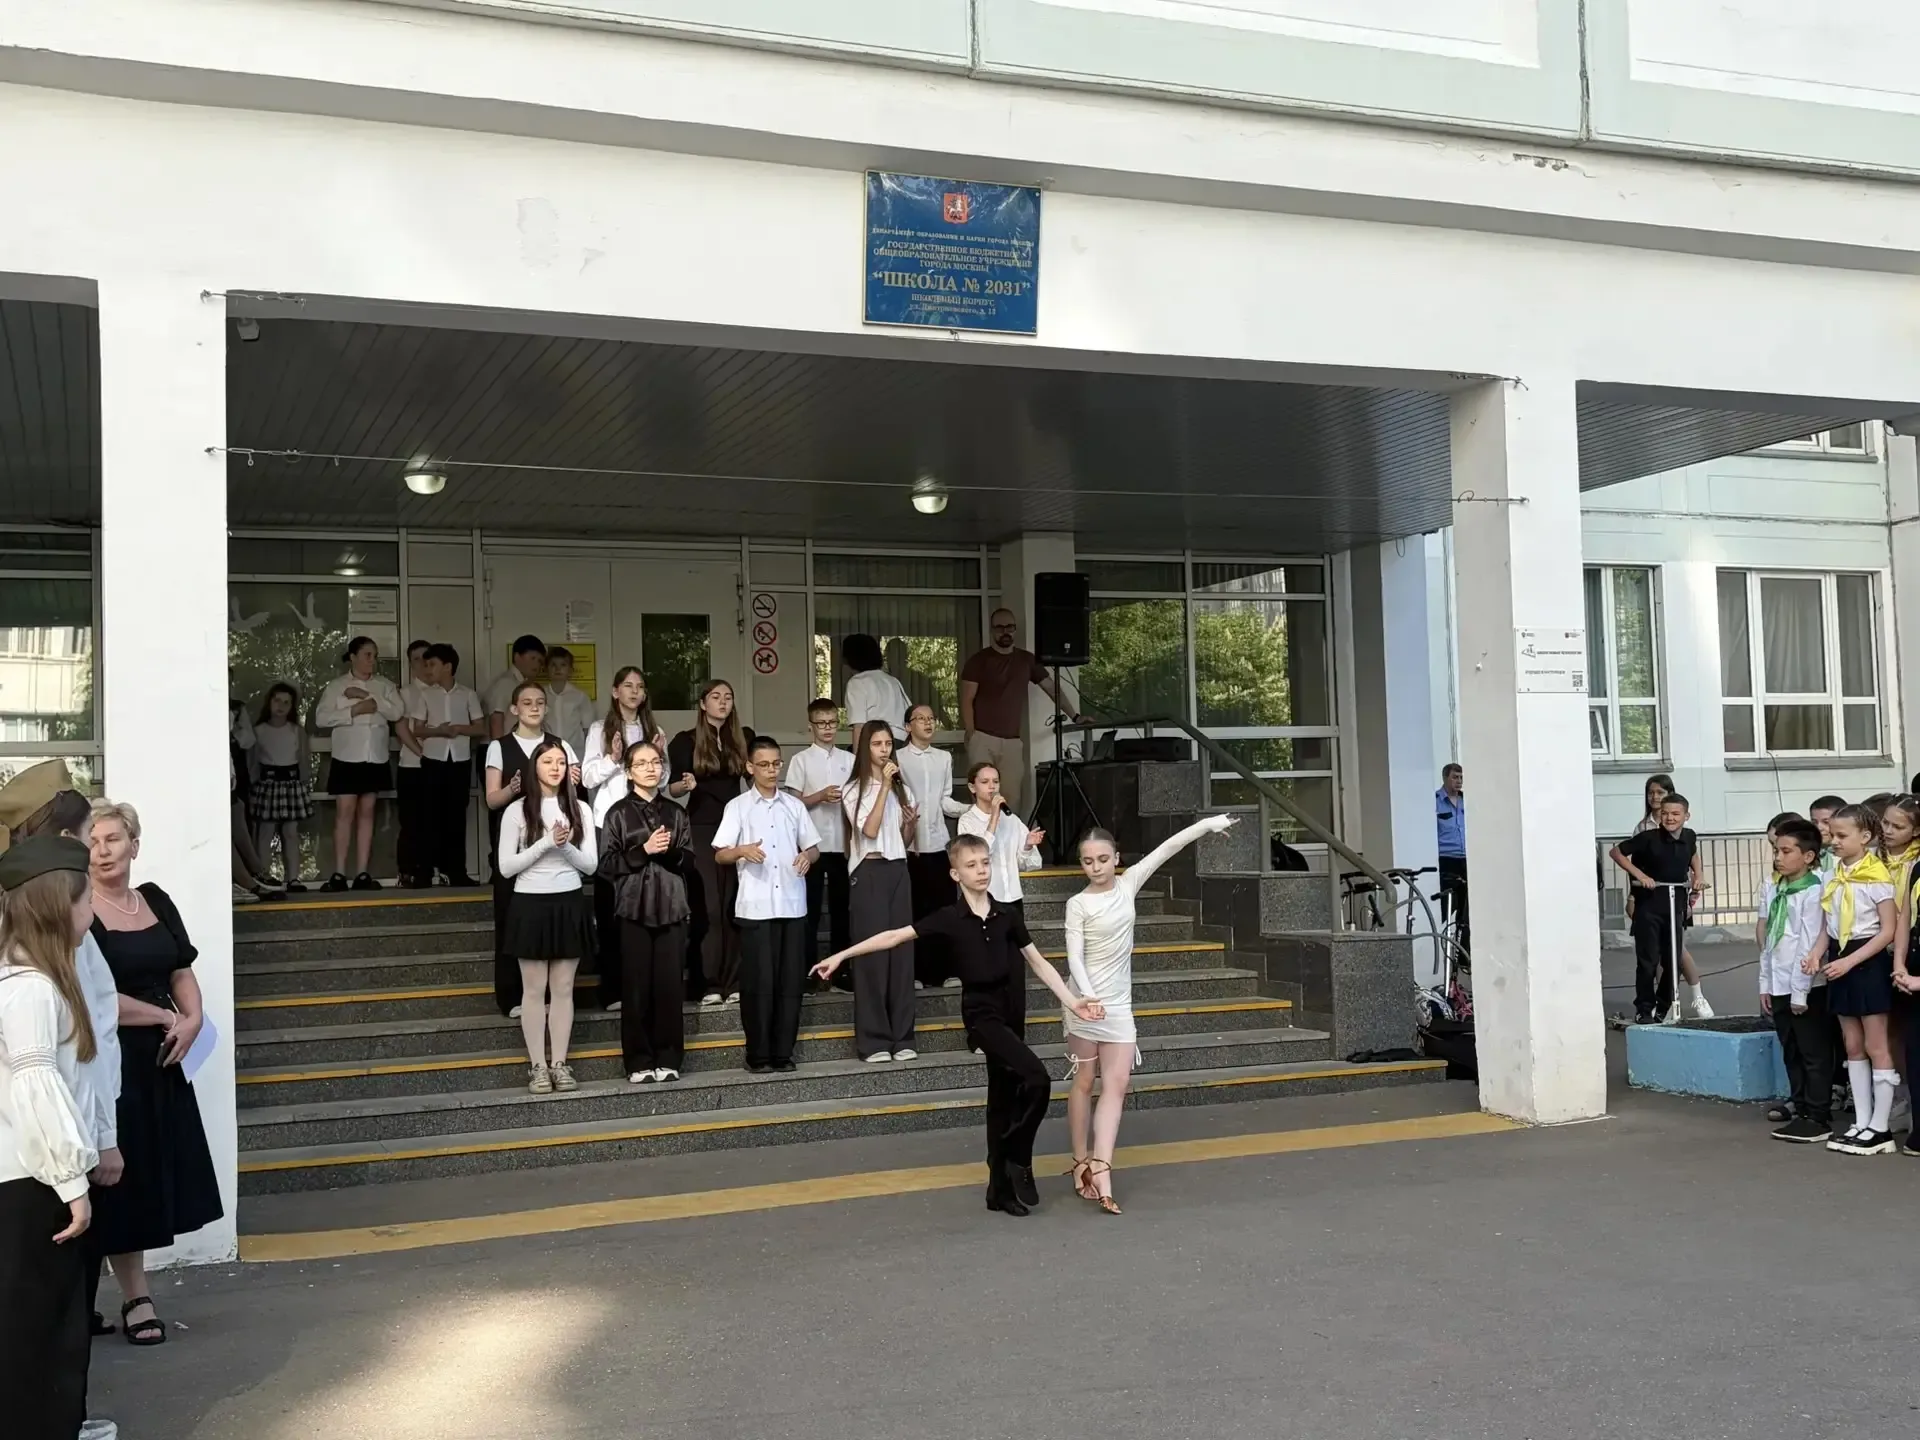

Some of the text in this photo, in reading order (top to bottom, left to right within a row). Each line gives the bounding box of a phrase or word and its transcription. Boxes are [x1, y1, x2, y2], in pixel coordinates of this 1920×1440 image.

[887, 241, 1020, 258] ГОСУДАРСТВЕННОЕ БЮДЖЕТНОЕ
[873, 248, 1033, 268] ОБЩЕОБРАЗОВАТЕЛЬНОЕ УЧРЕЖДЕНИЕ
[919, 260, 989, 272] ГОРОДА МОСКВЫ
[961, 277, 980, 293] №
[911, 293, 995, 306] ШКОЛЬНЫЙ КОРПУС
